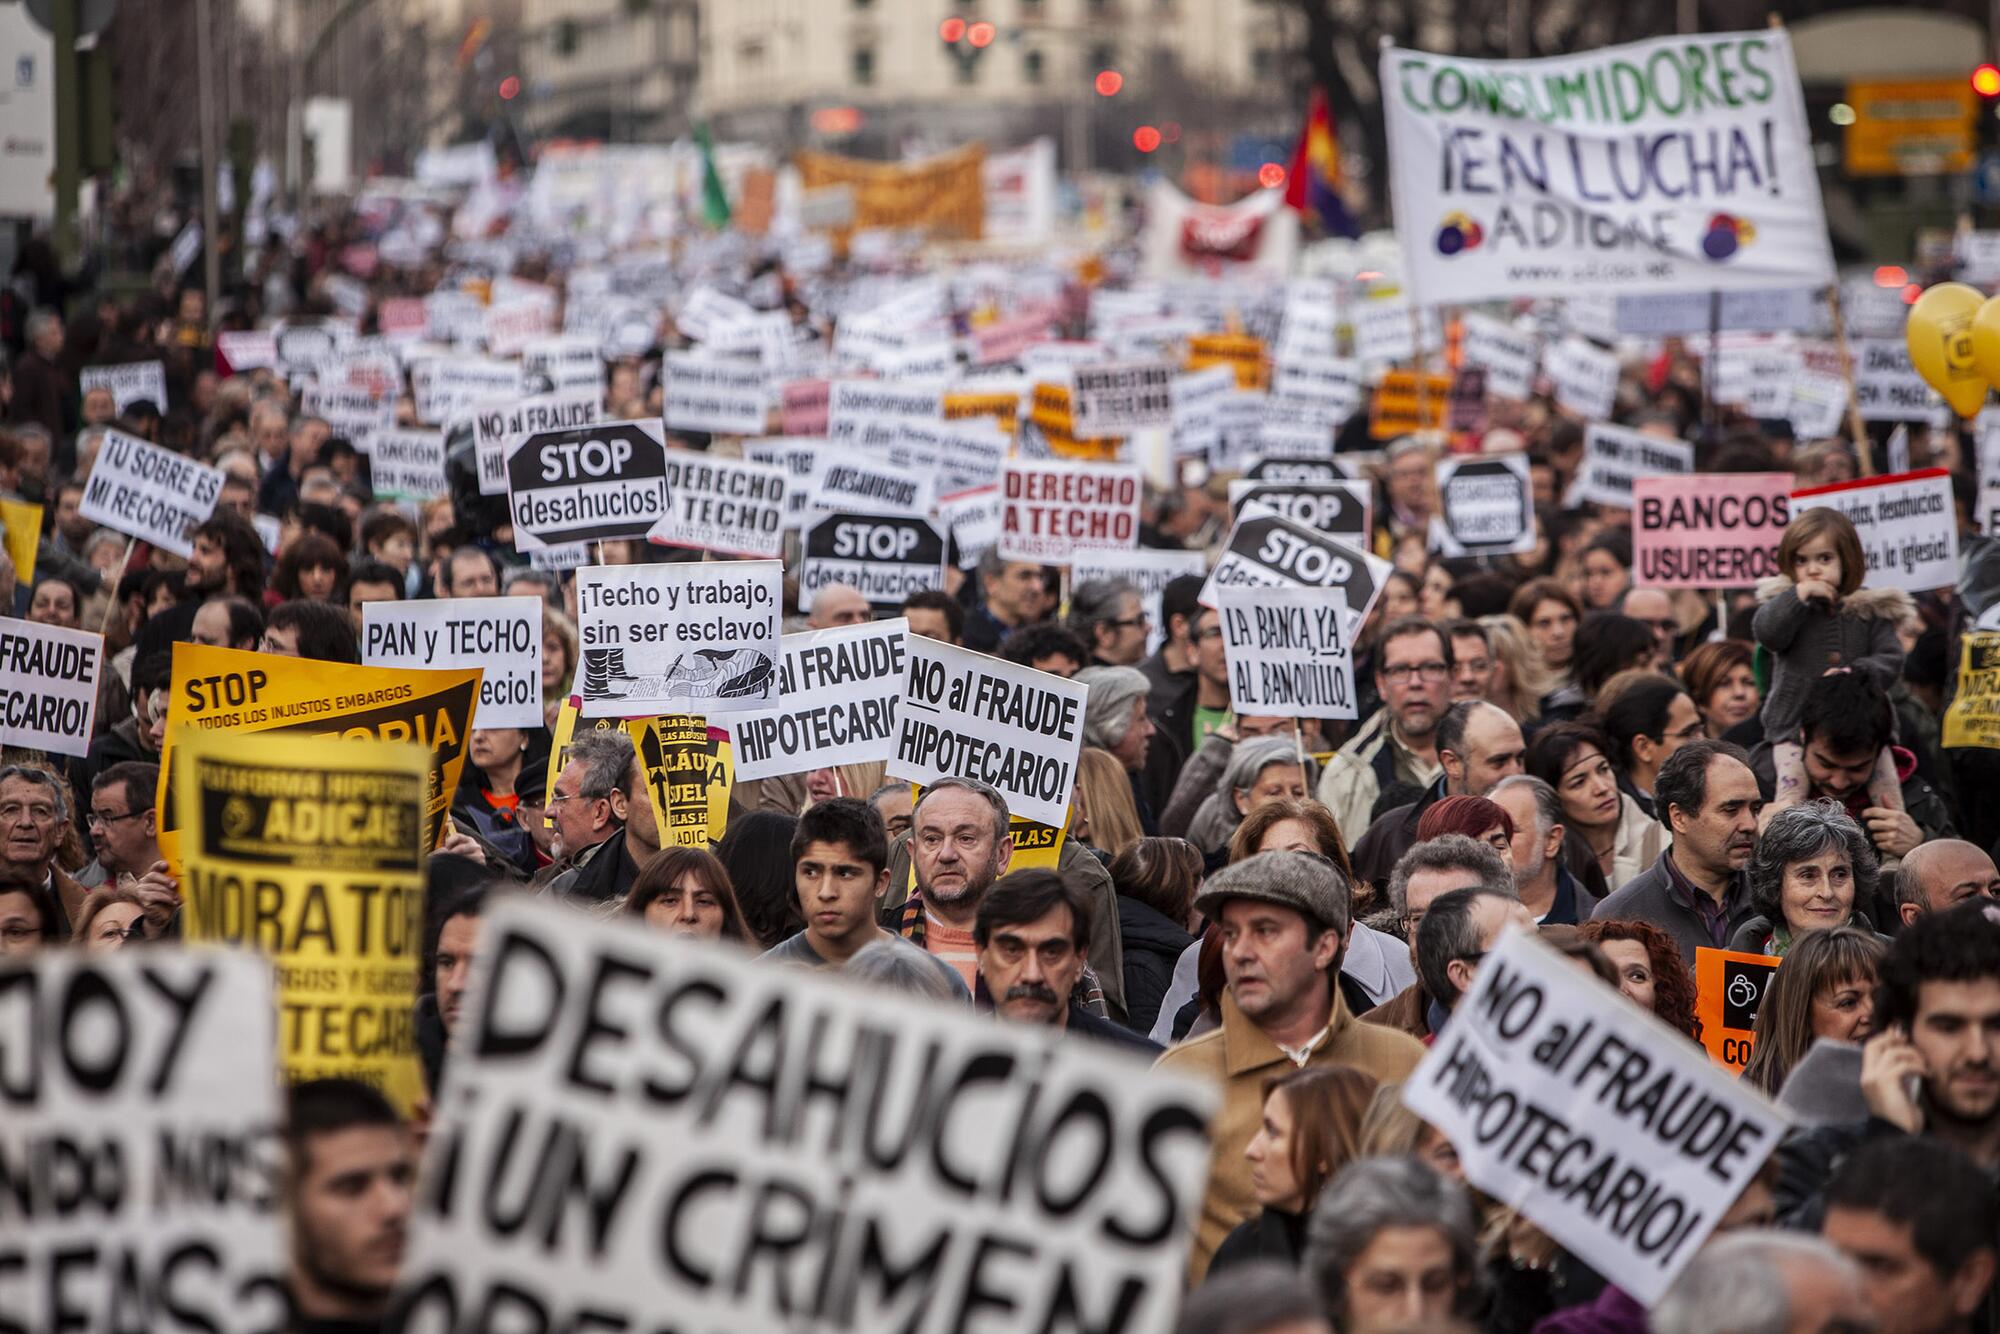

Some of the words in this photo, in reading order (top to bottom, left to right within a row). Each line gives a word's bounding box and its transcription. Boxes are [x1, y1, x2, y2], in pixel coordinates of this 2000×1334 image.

[1401, 39, 1774, 124] CONSUMIDORES
[1567, 119, 1781, 202] LUCHA!
[478, 415, 504, 439] NO
[508, 416, 522, 434] al
[527, 401, 595, 431] FRAUDE
[105, 435, 131, 469] TU
[130, 447, 194, 495] SOBRE
[193, 468, 219, 505] ES
[539, 438, 633, 482] STOP
[667, 462, 785, 503] DERECHO
[86, 476, 112, 509] MI
[518, 480, 666, 528] desahucios!
[1005, 470, 1136, 506] DERECHO
[684, 497, 780, 533] TECHO
[1004, 505, 1020, 533] A
[1027, 506, 1132, 540] TECHO
[1641, 495, 1790, 530] BANCOS
[833, 522, 919, 560] STOP
[1258, 528, 1353, 587] STOP
[1643, 546, 1781, 581] USUREROS
[581, 580, 660, 614] ¡Techo
[666, 586, 681, 611] y
[686, 579, 774, 610] trabajo,
[367, 622, 416, 657] PAN
[424, 630, 439, 664] y
[445, 618, 536, 659] TECHO,
[583, 619, 620, 645] sin
[629, 622, 669, 643] ser
[676, 615, 773, 642] esclavo!
[1226, 606, 1252, 647] LA
[1255, 604, 1317, 656] BANCA,
[0, 633, 96, 684] FRAUDE
[779, 652, 797, 695] al
[799, 633, 905, 690] FRAUDE
[185, 669, 268, 713] STOP
[480, 670, 536, 706] ecio!
[907, 656, 946, 706] NO
[949, 670, 974, 714] al
[975, 674, 1079, 743] FRAUDE
[1236, 661, 1257, 703] AL
[196, 711, 241, 730] TODOS
[244, 708, 268, 725] LOS
[271, 698, 332, 719] INJUSTOS
[336, 684, 413, 710] EMBARGOS
[897, 717, 1070, 806] HIPOTECARIO!
[263, 798, 402, 848] ADICAE
[473, 928, 1210, 1247] DESAHUCIOS
[1477, 962, 1544, 1042] NO
[1532, 1019, 1594, 1072] al
[1573, 1032, 1765, 1184] FRAUDE
[1432, 1037, 1703, 1268] HIPOTECARIO!
[662, 1164, 1146, 1334] CRIMEN
